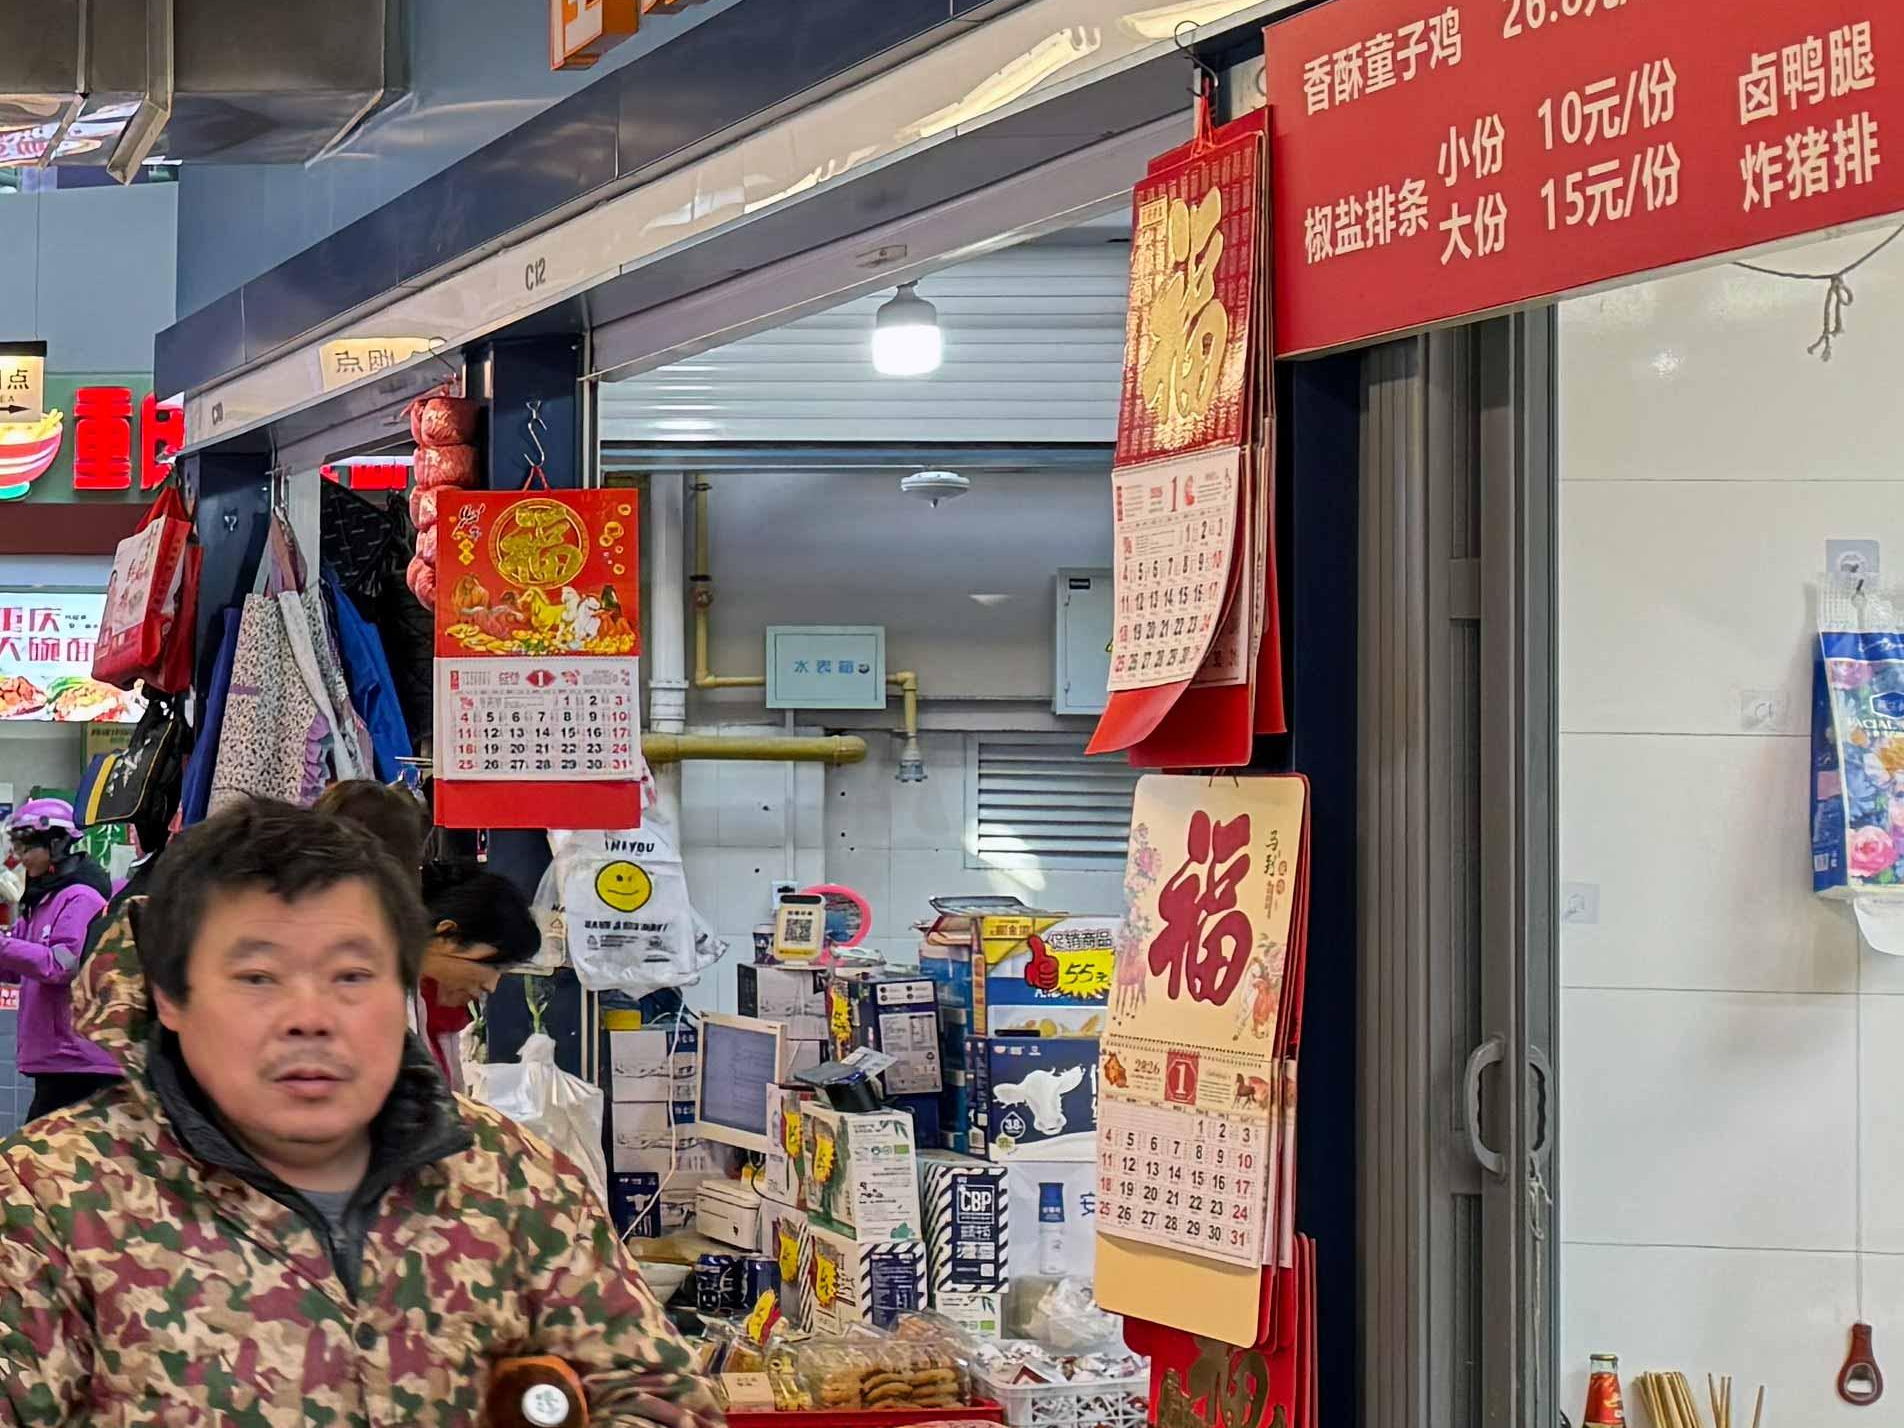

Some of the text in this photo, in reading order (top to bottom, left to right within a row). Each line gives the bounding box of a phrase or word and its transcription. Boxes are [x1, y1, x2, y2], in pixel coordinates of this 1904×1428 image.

[1302, 6, 1462, 116] 香酥童子鸡
[1738, 19, 1876, 126] 卤鸭腿
[1437, 58, 1678, 187] 小份 10元/份
[1739, 111, 1881, 214] 炸猪排
[1303, 142, 1681, 266] 椒盐排条 大份 15元/份
[524, 257, 547, 292] C12
[460, 712, 627, 723] 4 5 6 7 8 9 10
[564, 696, 623, 706] 1 2 3
[458, 727, 627, 739] 11 12 13 14 15 16 17
[459, 743, 627, 754] 18 19 20 21 22 23 24
[459, 760, 627, 770] 25 26 27 28 29 30 31
[1148, 810, 1253, 1007] 福
[1049, 930, 1114, 952] 促销商品
[1174, 1064, 1185, 1095] 1
[1105, 1128, 1252, 1169] 4 5 6 7 8 9 10
[1198, 1120, 1251, 1143] 1 2 3
[1102, 1152, 1251, 1195] 11 12 13 14 15 16 17
[959, 1191, 992, 1213] CBP
[1100, 1177, 1248, 1220] 18 19 20 21 22 23 24
[1099, 1201, 1245, 1247] 25 26 27 28 29 30 31
